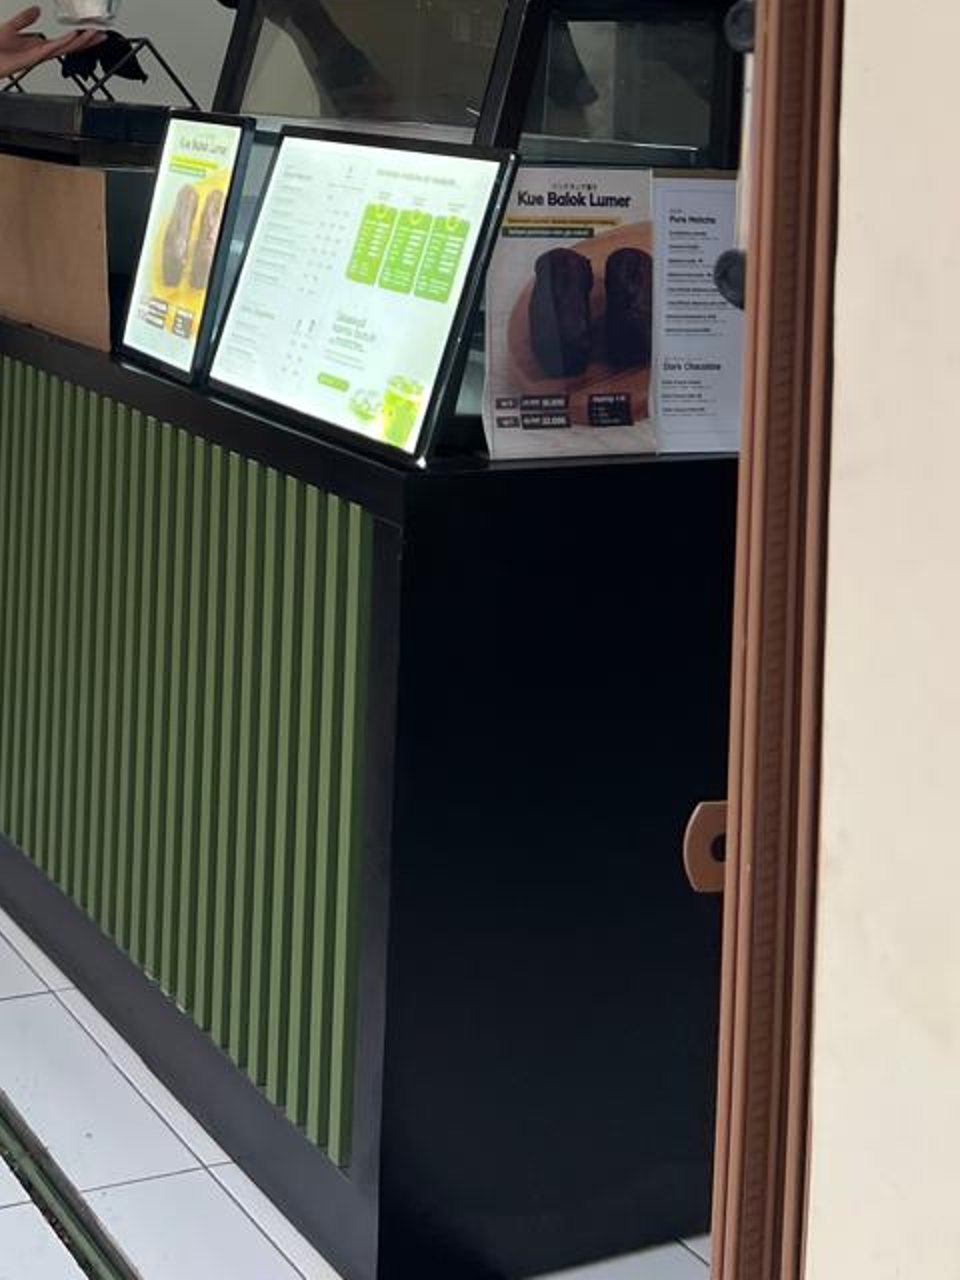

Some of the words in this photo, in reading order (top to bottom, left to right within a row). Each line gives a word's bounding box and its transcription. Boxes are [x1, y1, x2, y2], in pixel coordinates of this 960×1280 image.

[517, 191, 544, 207] Kue
[547, 191, 587, 208] Balok
[589, 192, 632, 209] Lumer
